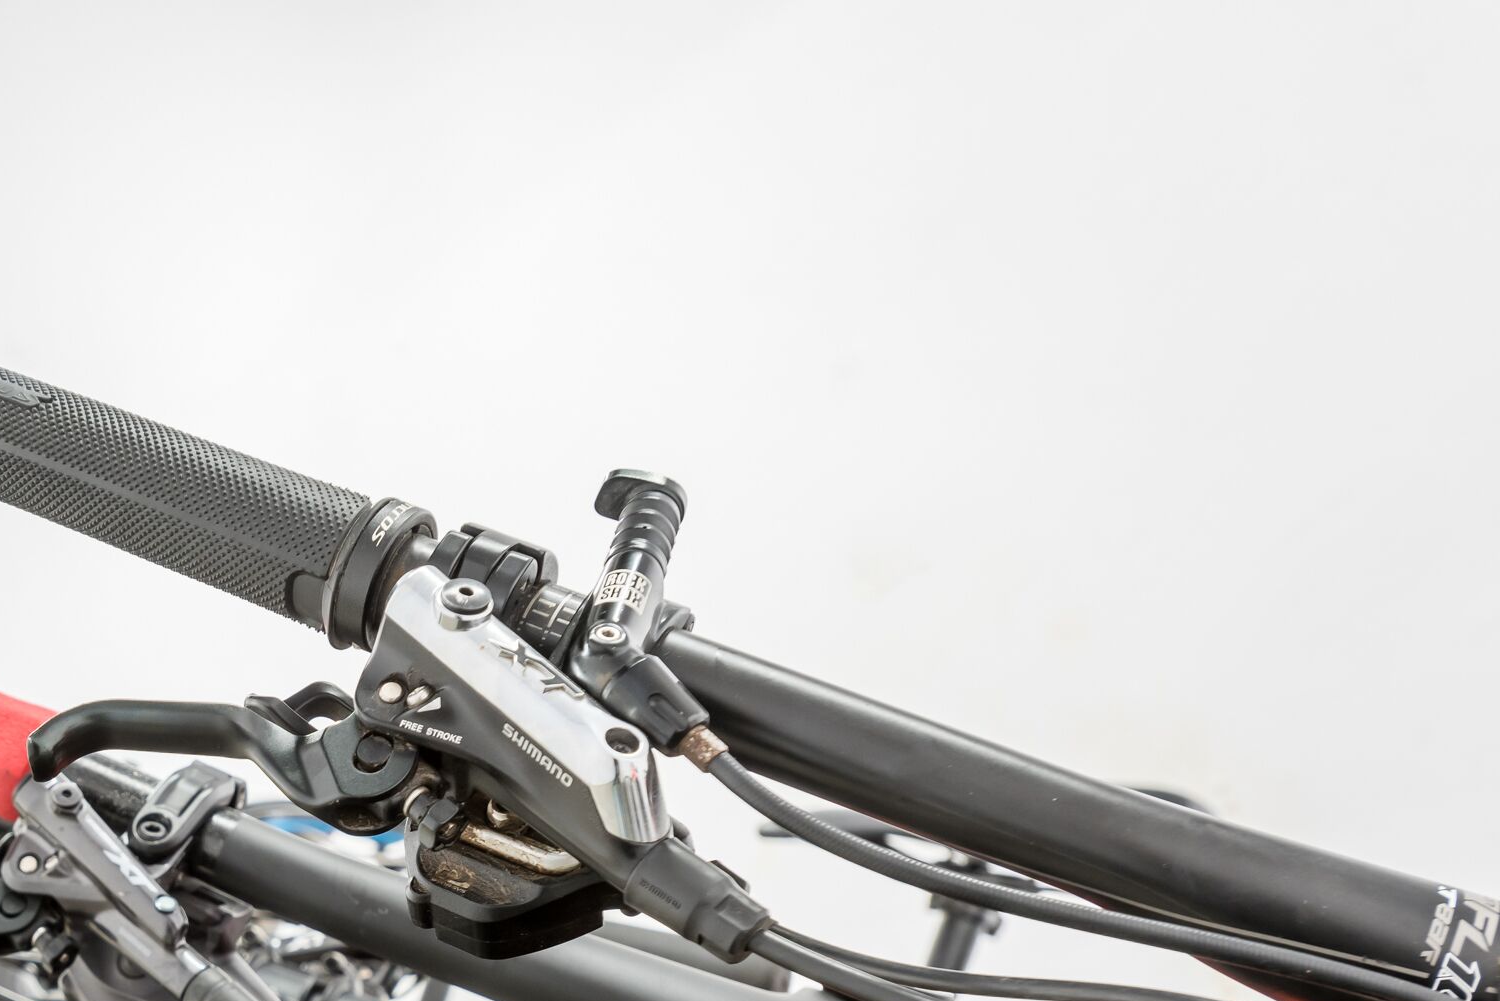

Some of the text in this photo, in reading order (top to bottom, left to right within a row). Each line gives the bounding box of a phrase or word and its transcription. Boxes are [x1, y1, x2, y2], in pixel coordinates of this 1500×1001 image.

[603, 571, 649, 594] ROCK
[399, 718, 464, 745] FREE STROKE
[501, 722, 574, 788] SHIMANO
